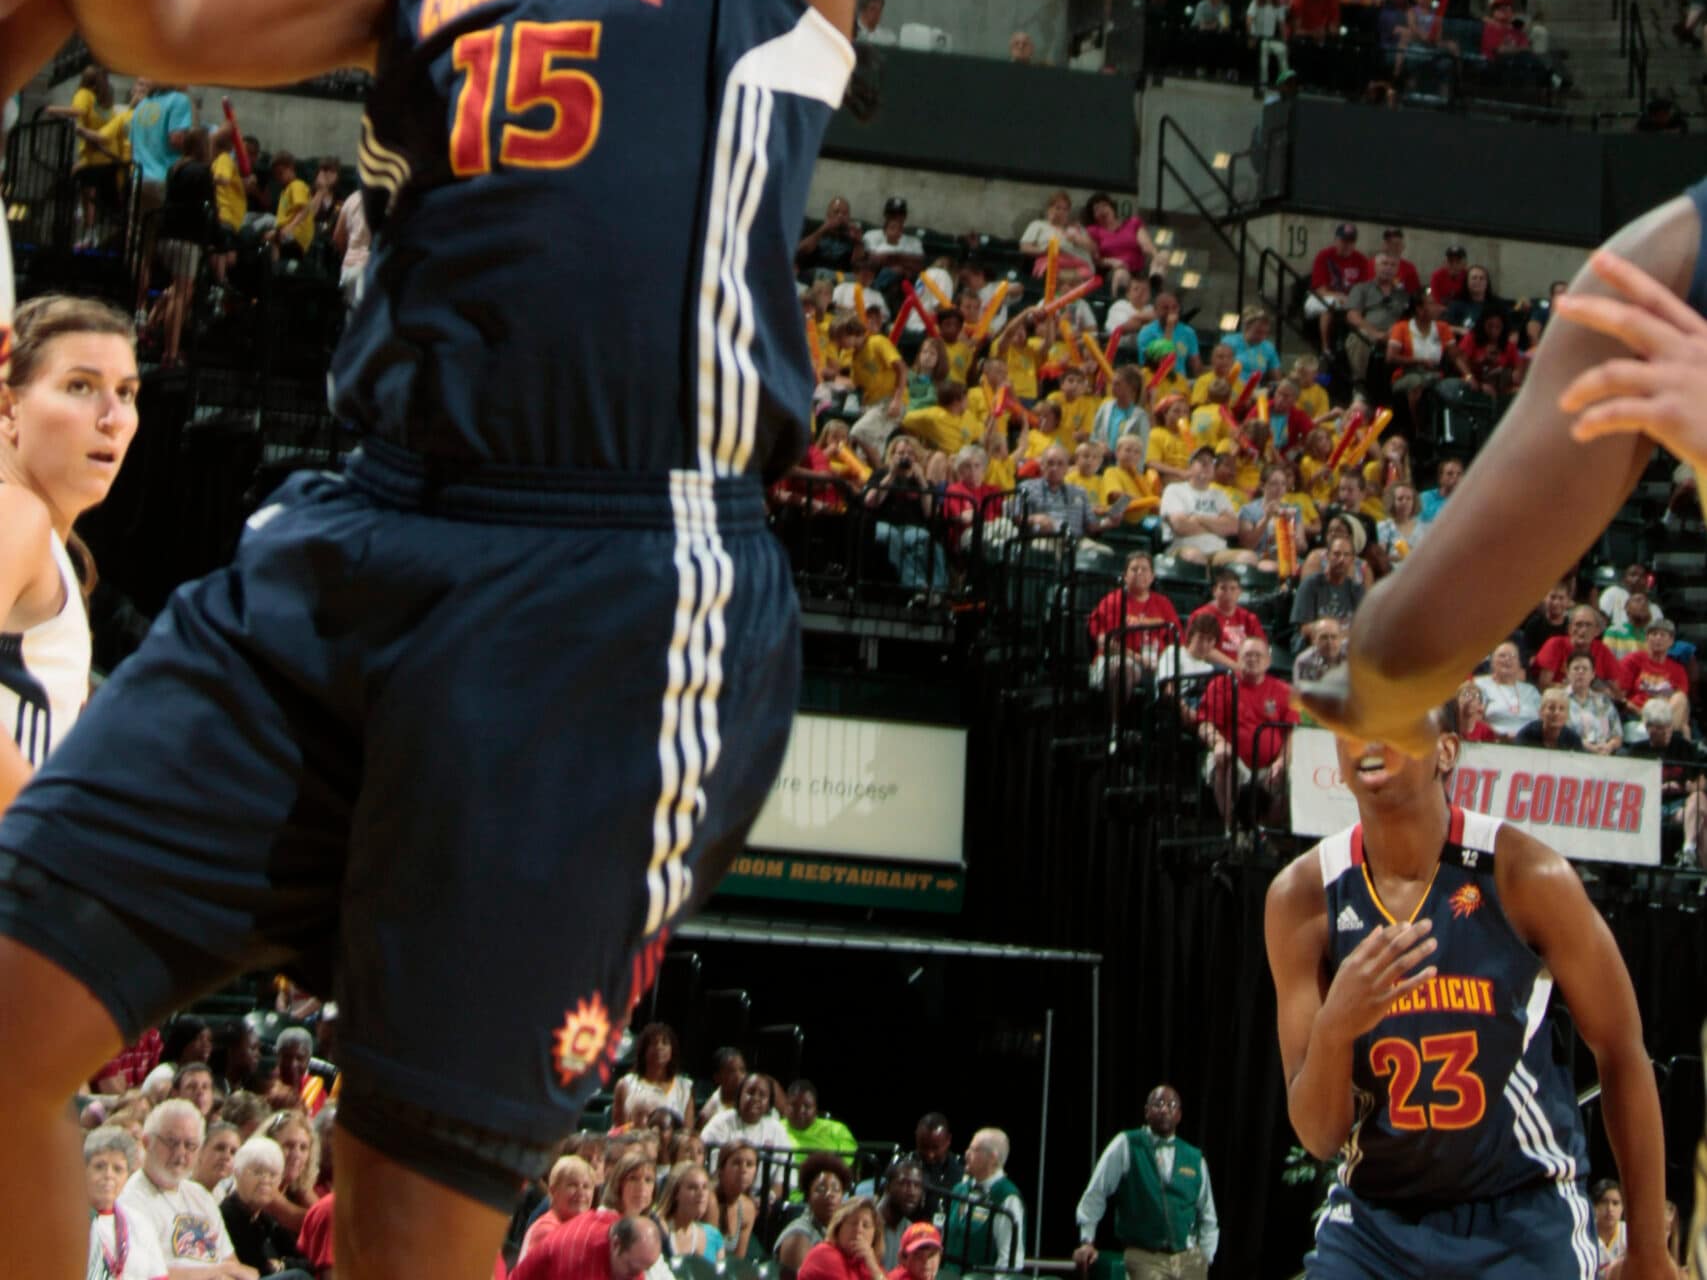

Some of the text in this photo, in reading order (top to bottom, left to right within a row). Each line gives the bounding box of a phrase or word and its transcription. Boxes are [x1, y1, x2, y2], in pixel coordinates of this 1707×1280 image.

[449, 19, 603, 177] 15
[1287, 224, 1309, 258] 19
[1505, 770, 1646, 833] CORNER
[789, 860, 934, 892] RESTAURANT
[1368, 1030, 1487, 1132] 23
